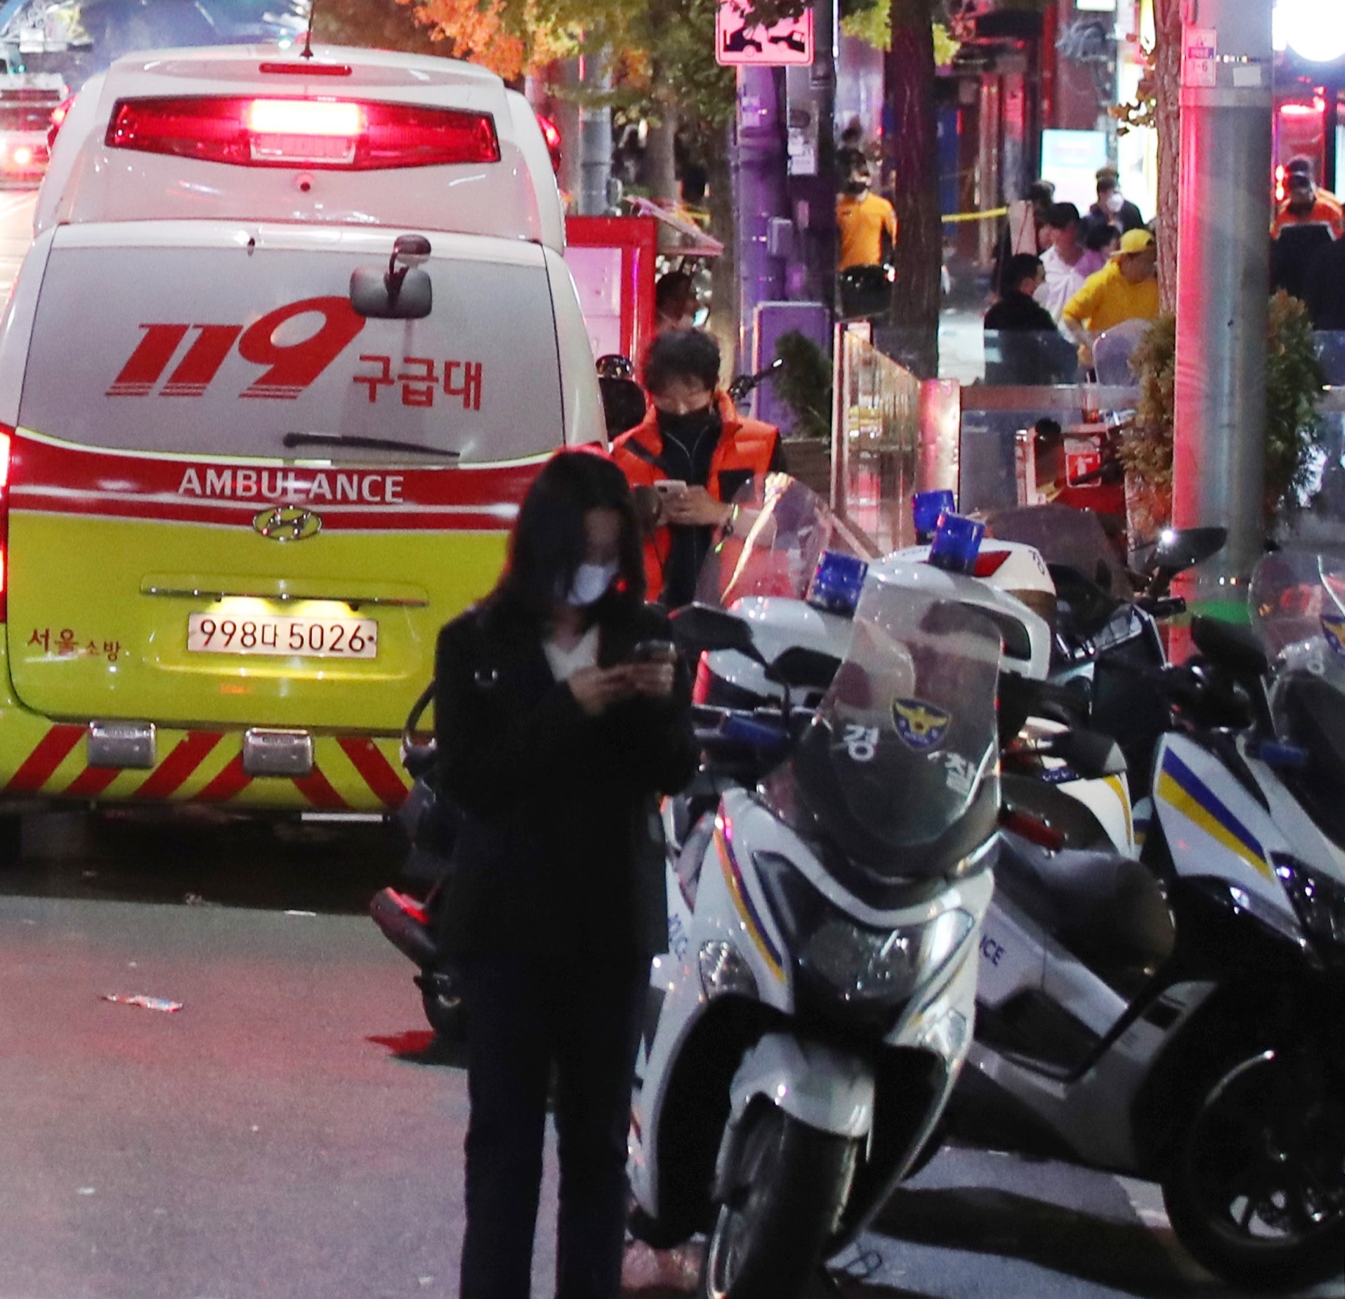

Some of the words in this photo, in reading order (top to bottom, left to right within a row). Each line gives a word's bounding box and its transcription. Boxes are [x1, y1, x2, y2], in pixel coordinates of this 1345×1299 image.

[104, 295, 367, 400] 119
[352, 354, 482, 411] 구급대
[178, 467, 404, 503] AMBULANCE
[200, 618, 278, 648] 998다
[288, 622, 366, 653] 5026
